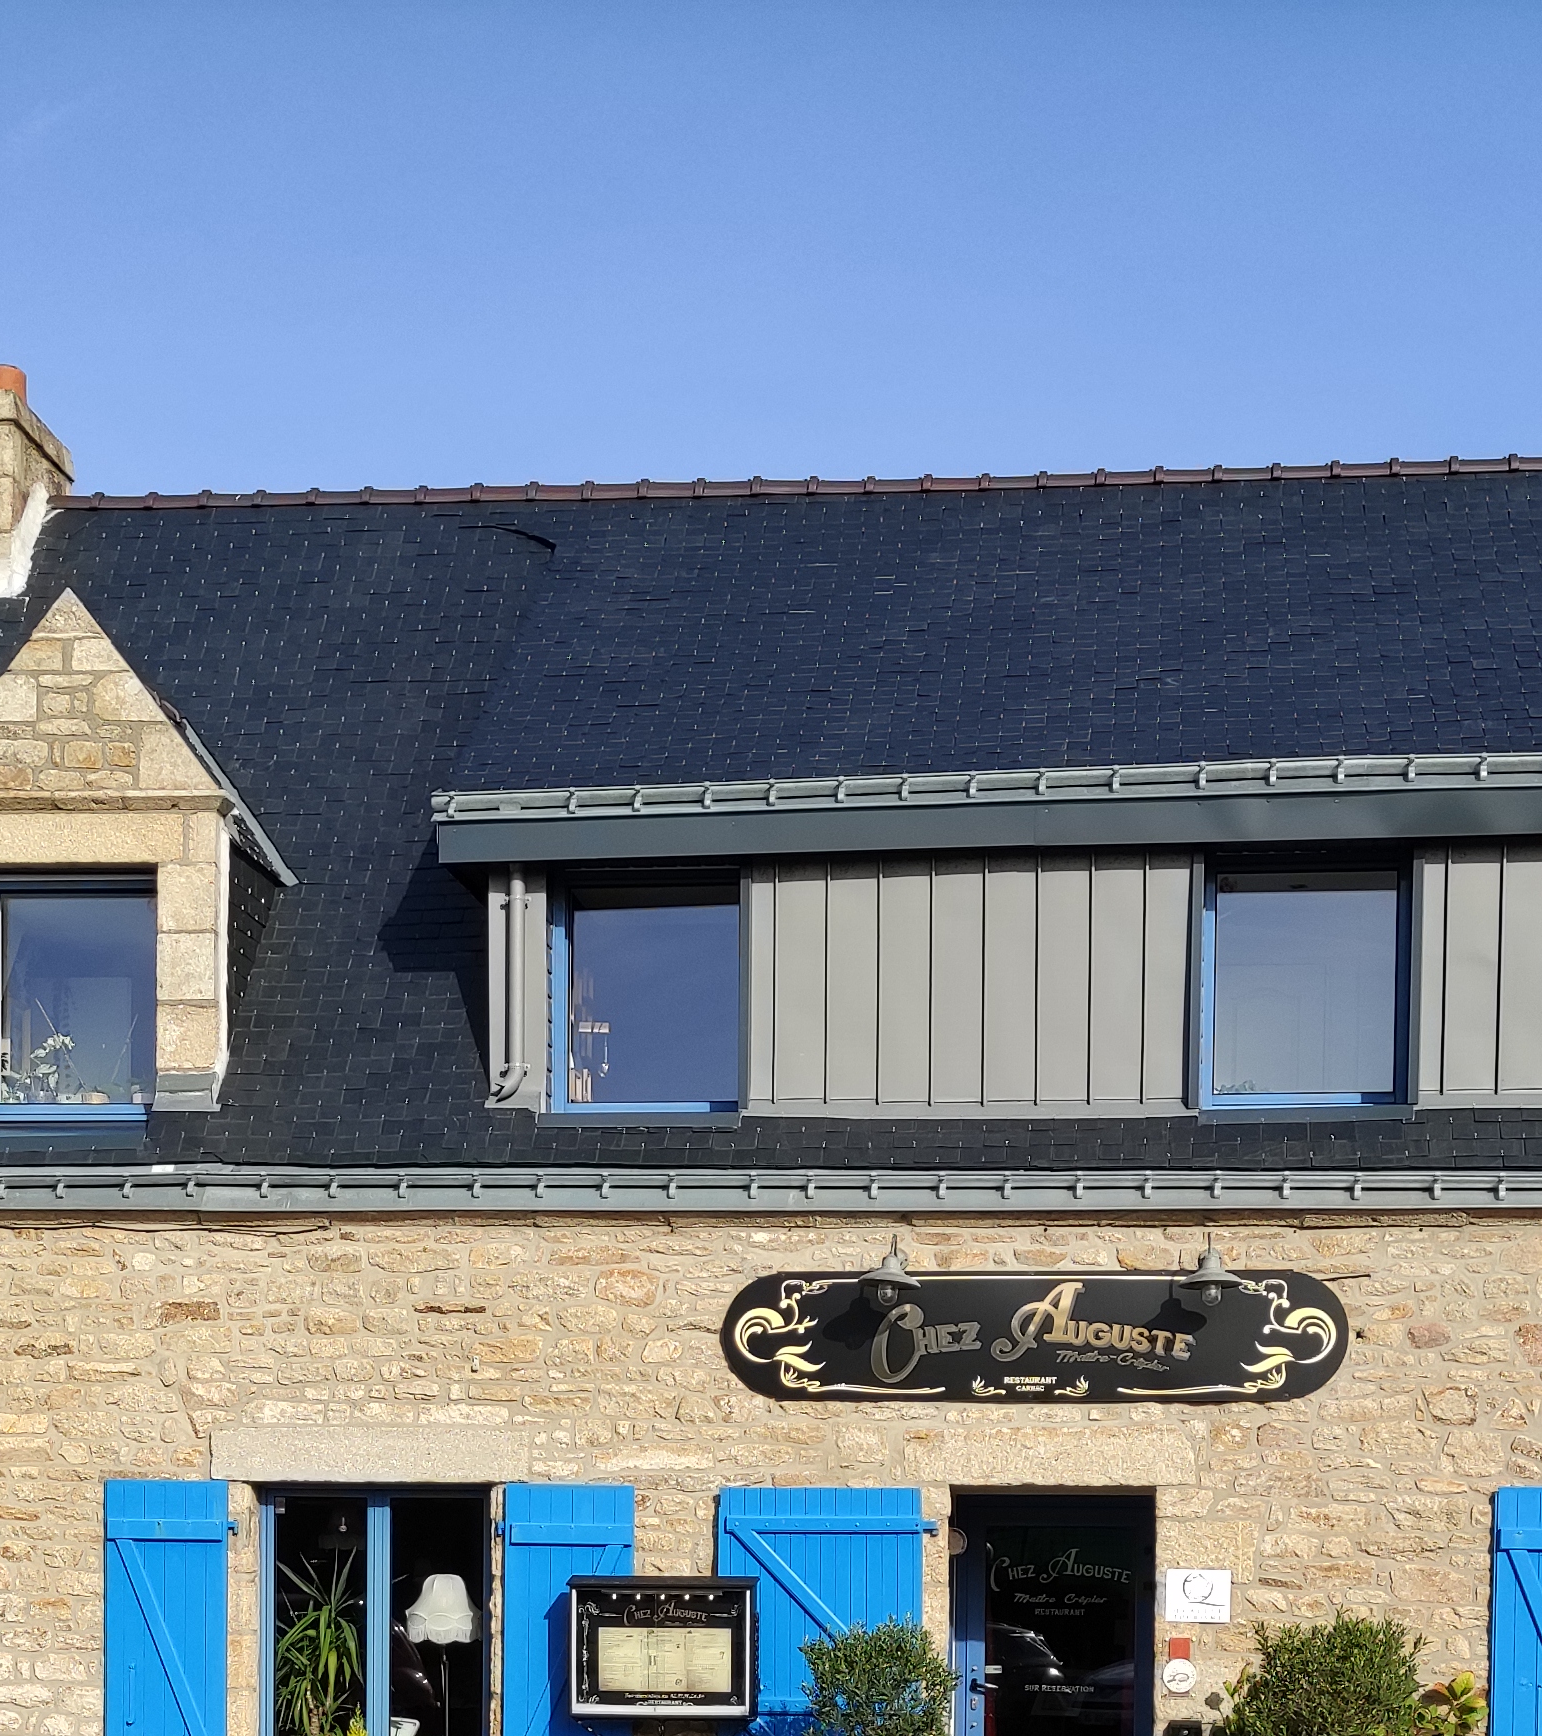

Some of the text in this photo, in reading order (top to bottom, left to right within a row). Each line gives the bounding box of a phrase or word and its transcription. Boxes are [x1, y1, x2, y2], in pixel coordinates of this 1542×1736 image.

[990, 1281, 1197, 1362] AUGUSTE
[1004, 1376, 1058, 1384] RESTAURANT
[1039, 1548, 1132, 1584] AUGUSTE
[652, 1600, 709, 1622] AUGUSTE
[1034, 1607, 1086, 1616] RESTAURANT
[1024, 1684, 1040, 1692] SUR
